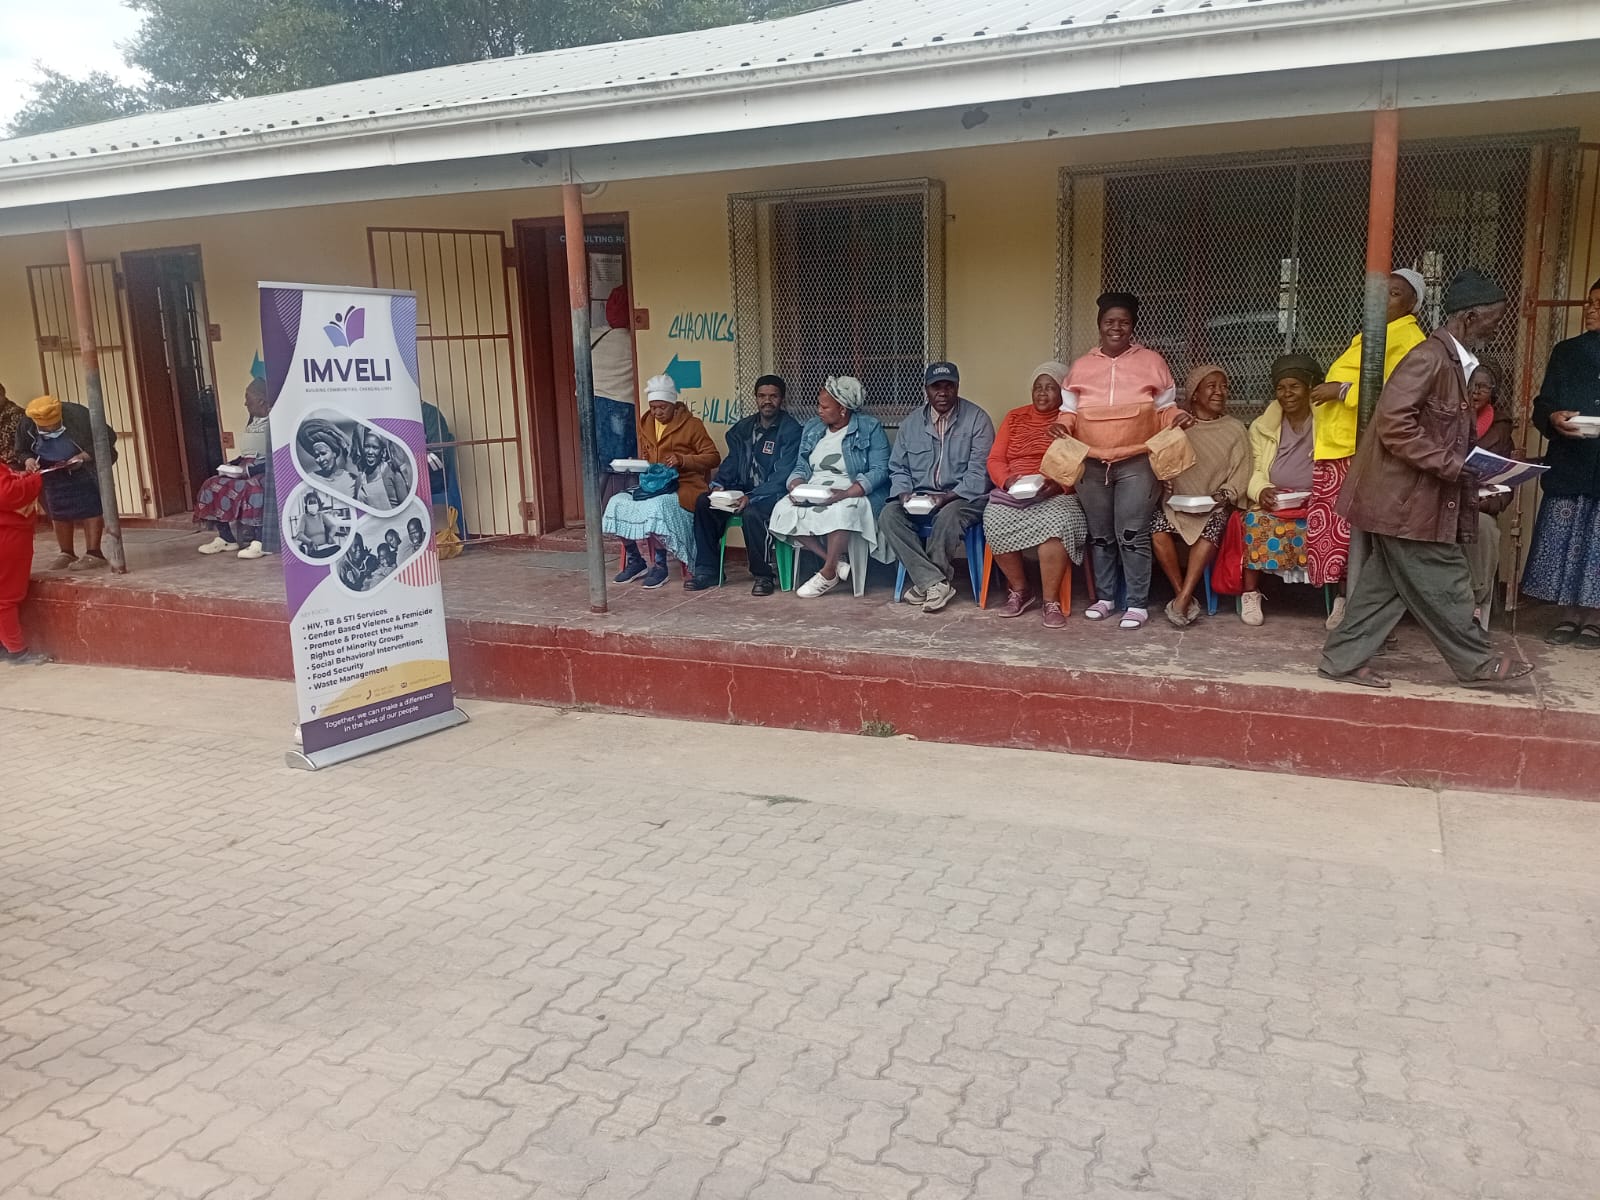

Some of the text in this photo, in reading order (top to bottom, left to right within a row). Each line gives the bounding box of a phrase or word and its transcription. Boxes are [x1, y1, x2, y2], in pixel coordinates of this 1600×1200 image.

[560, 235, 614, 243] CULTING
[668, 312, 735, 342] CHRONICS
[303, 358, 391, 383] IMVELI
[307, 621, 323, 630] HIV,
[324, 619, 335, 627] TB
[343, 614, 355, 623] STI
[356, 609, 388, 620] Services
[308, 629, 336, 640] Gender
[337, 622, 361, 634] Based
[362, 616, 394, 628] Violence
[401, 608, 433, 620] Femicide
[309, 620, 419, 650] Promote & Protect the Human
[310, 633, 404, 661] Rights of Minority Groups
[311, 638, 424, 670] Social Behavioral Interventions
[312, 661, 364, 680] Food Security
[313, 665, 388, 690] Waste Management
[325, 715, 356, 729] Together,
[367, 708, 380, 716] can
[380, 703, 398, 713] make
[404, 692, 434, 706] difference
[351, 722, 363, 730] the
[364, 717, 378, 727] lives
[386, 711, 397, 719] our
[398, 705, 419, 718] people
